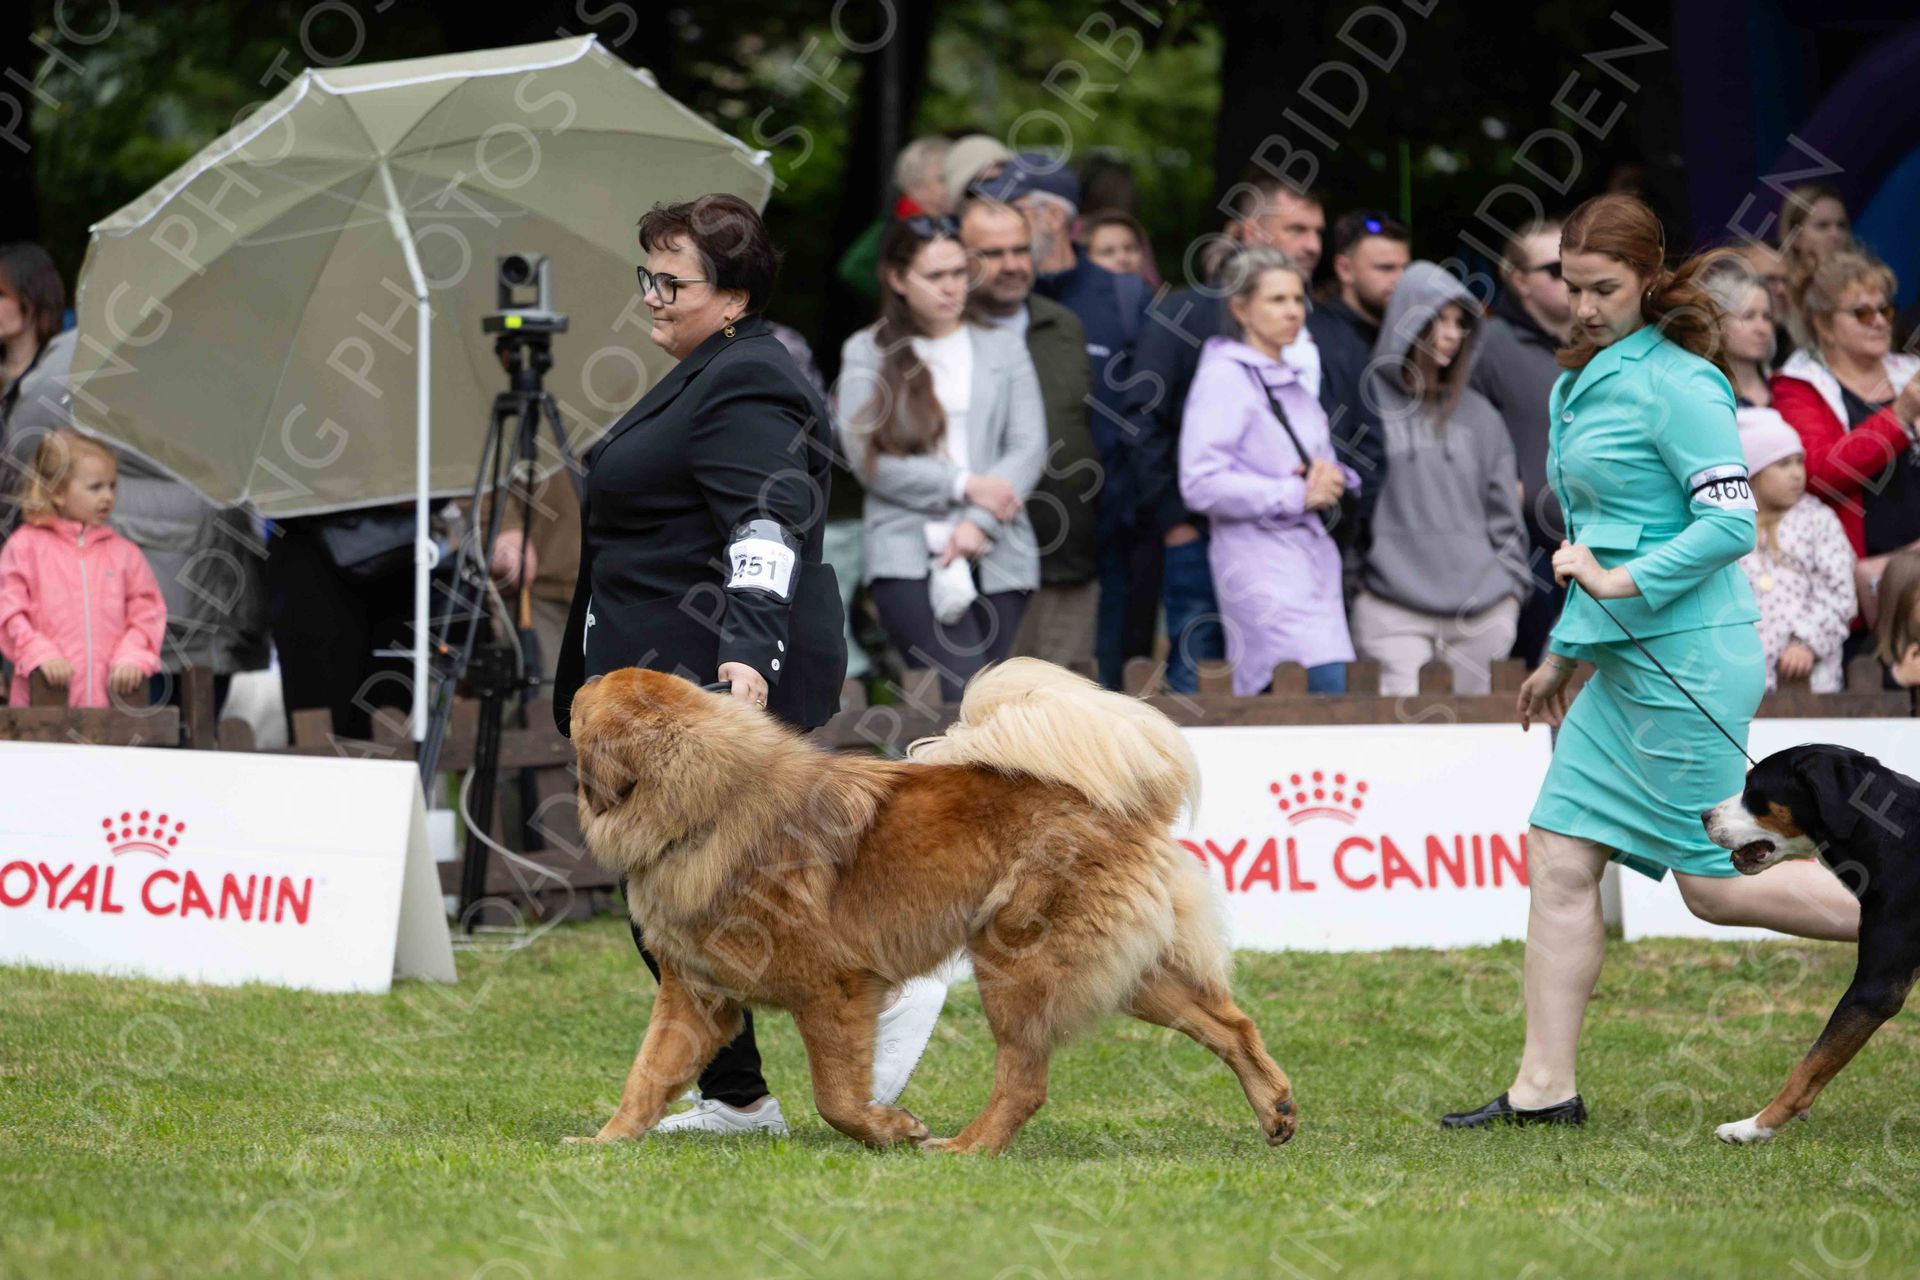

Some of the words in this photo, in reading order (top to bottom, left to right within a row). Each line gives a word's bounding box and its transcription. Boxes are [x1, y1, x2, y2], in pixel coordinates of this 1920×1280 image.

[1708, 480, 1749, 502] 460
[1333, 833, 1530, 889] CANIN
[0, 860, 124, 914] OYAL
[141, 869, 313, 924] CANIN
